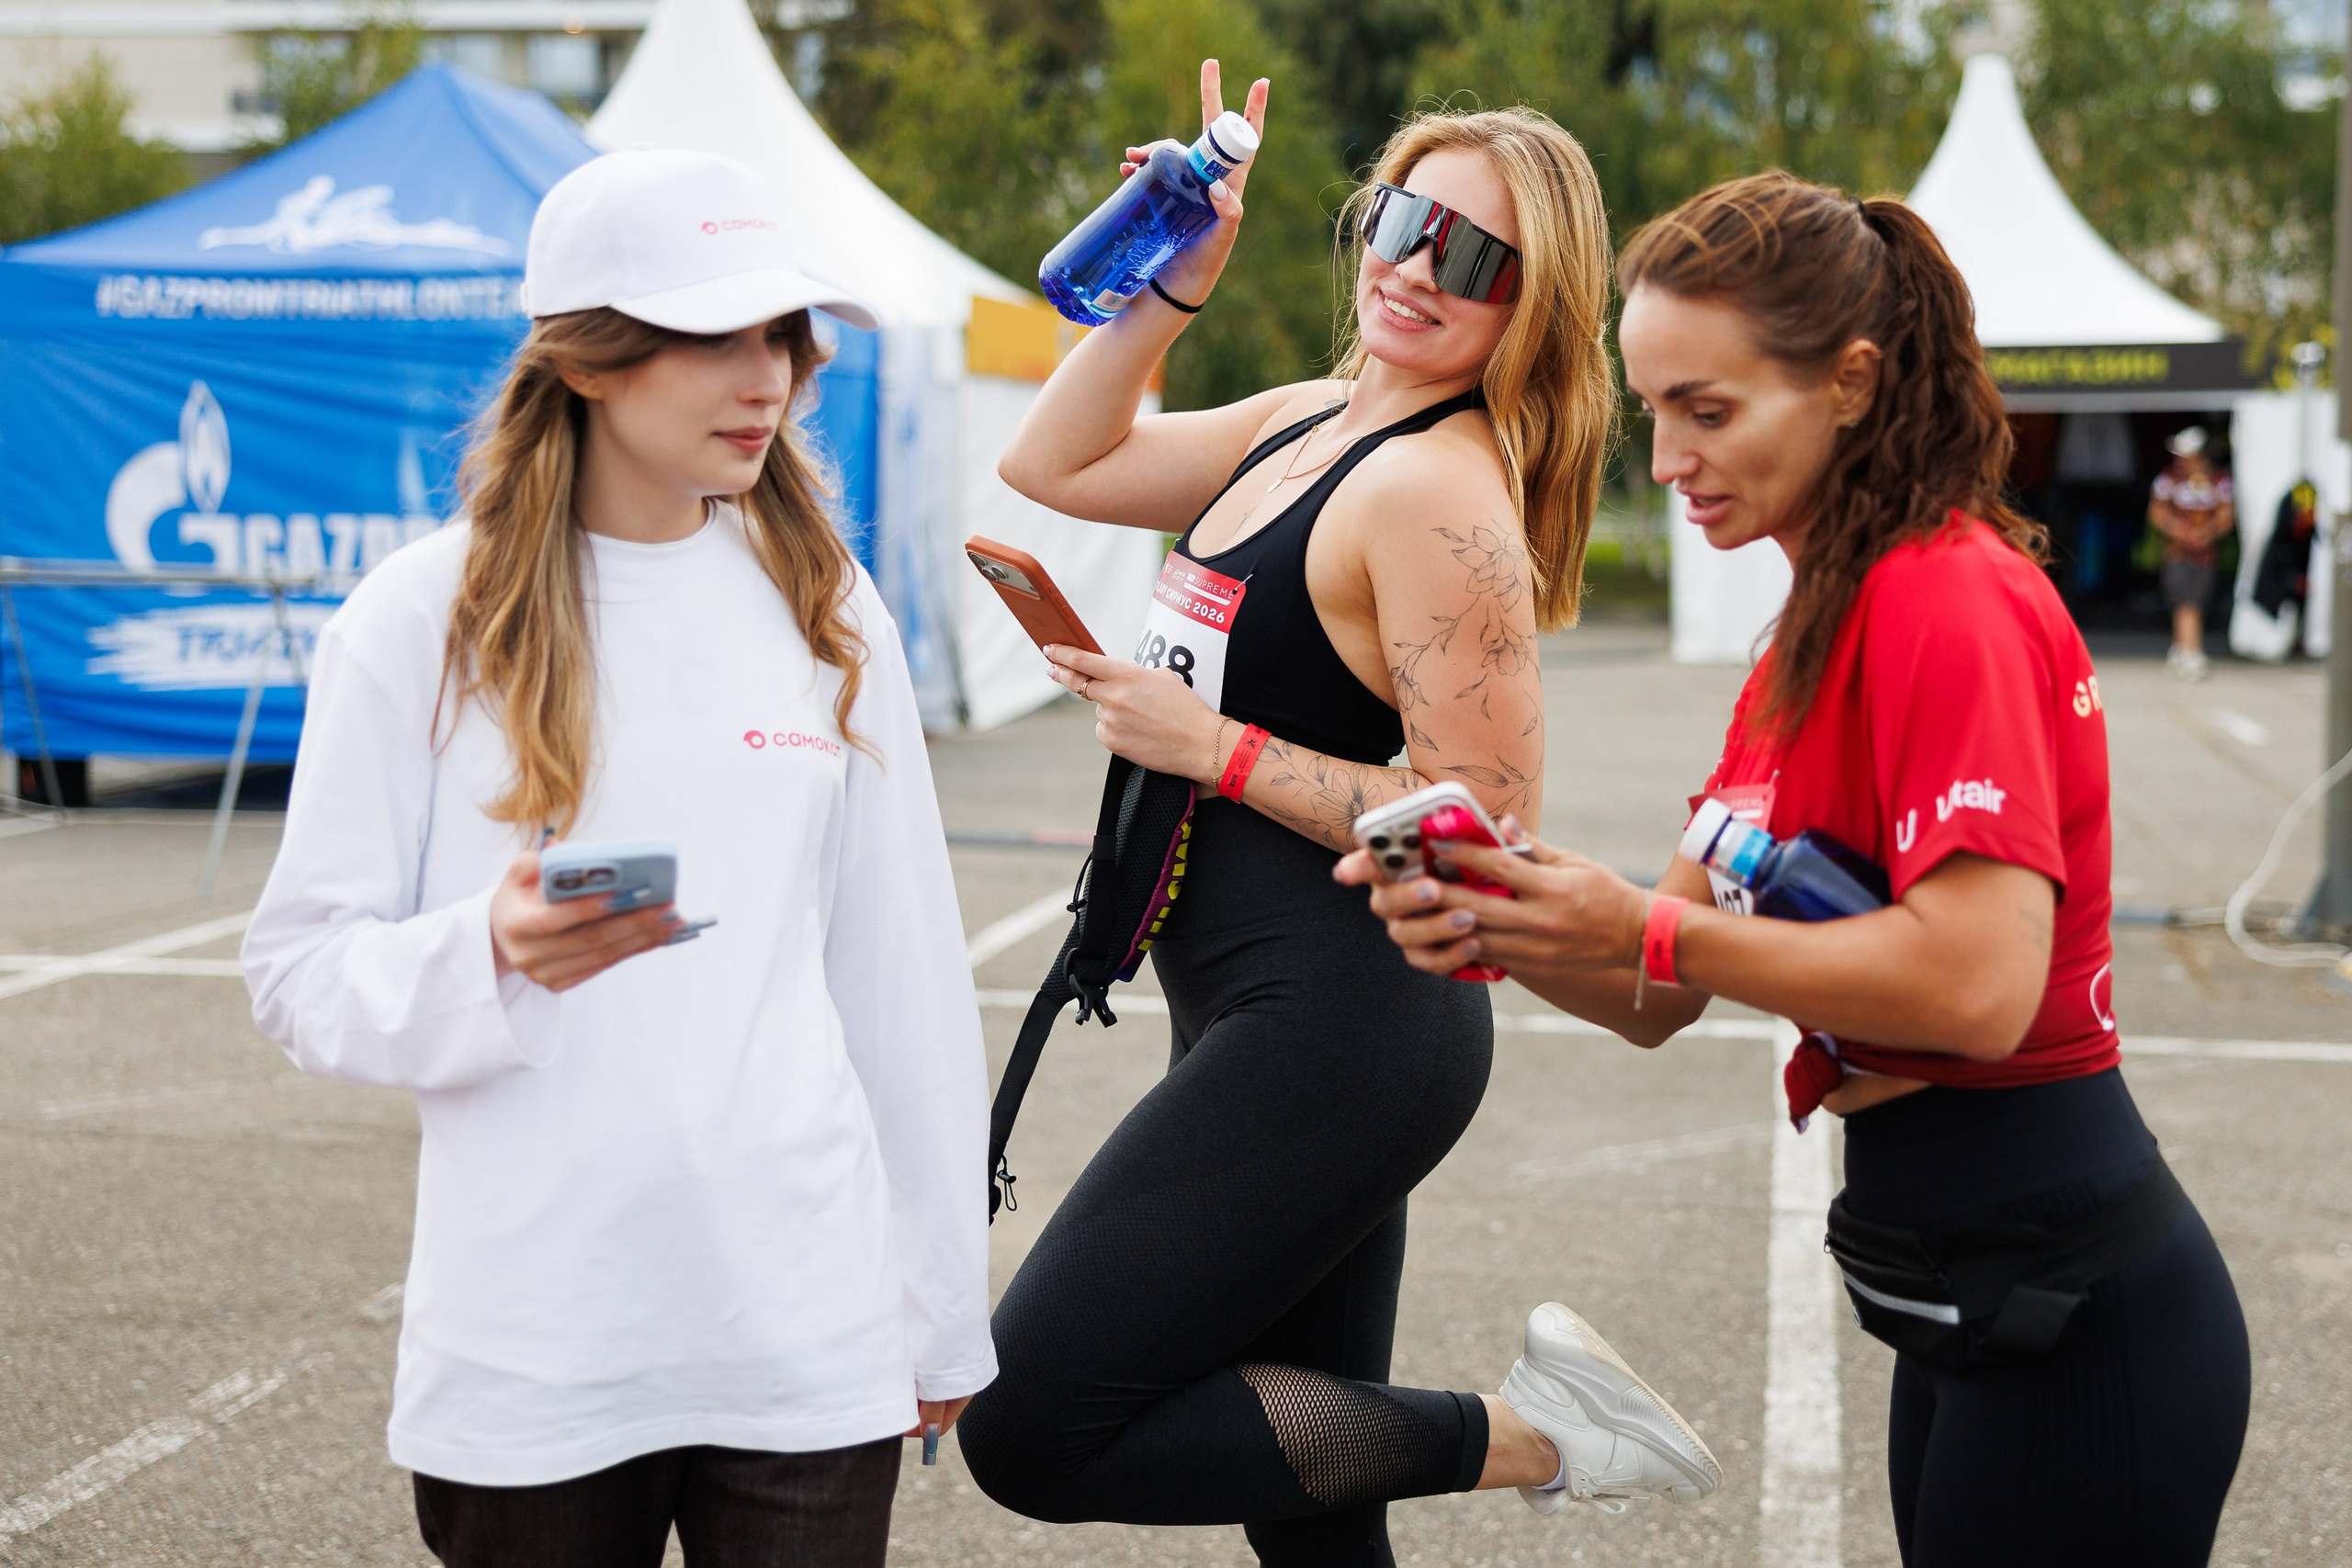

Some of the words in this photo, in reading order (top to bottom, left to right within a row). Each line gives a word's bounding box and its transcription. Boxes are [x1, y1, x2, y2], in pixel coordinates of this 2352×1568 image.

[1194, 575, 1234, 600] SUPREME
[1165, 587, 1193, 610] СИРИУС
[1193, 601, 1225, 624] 2026
